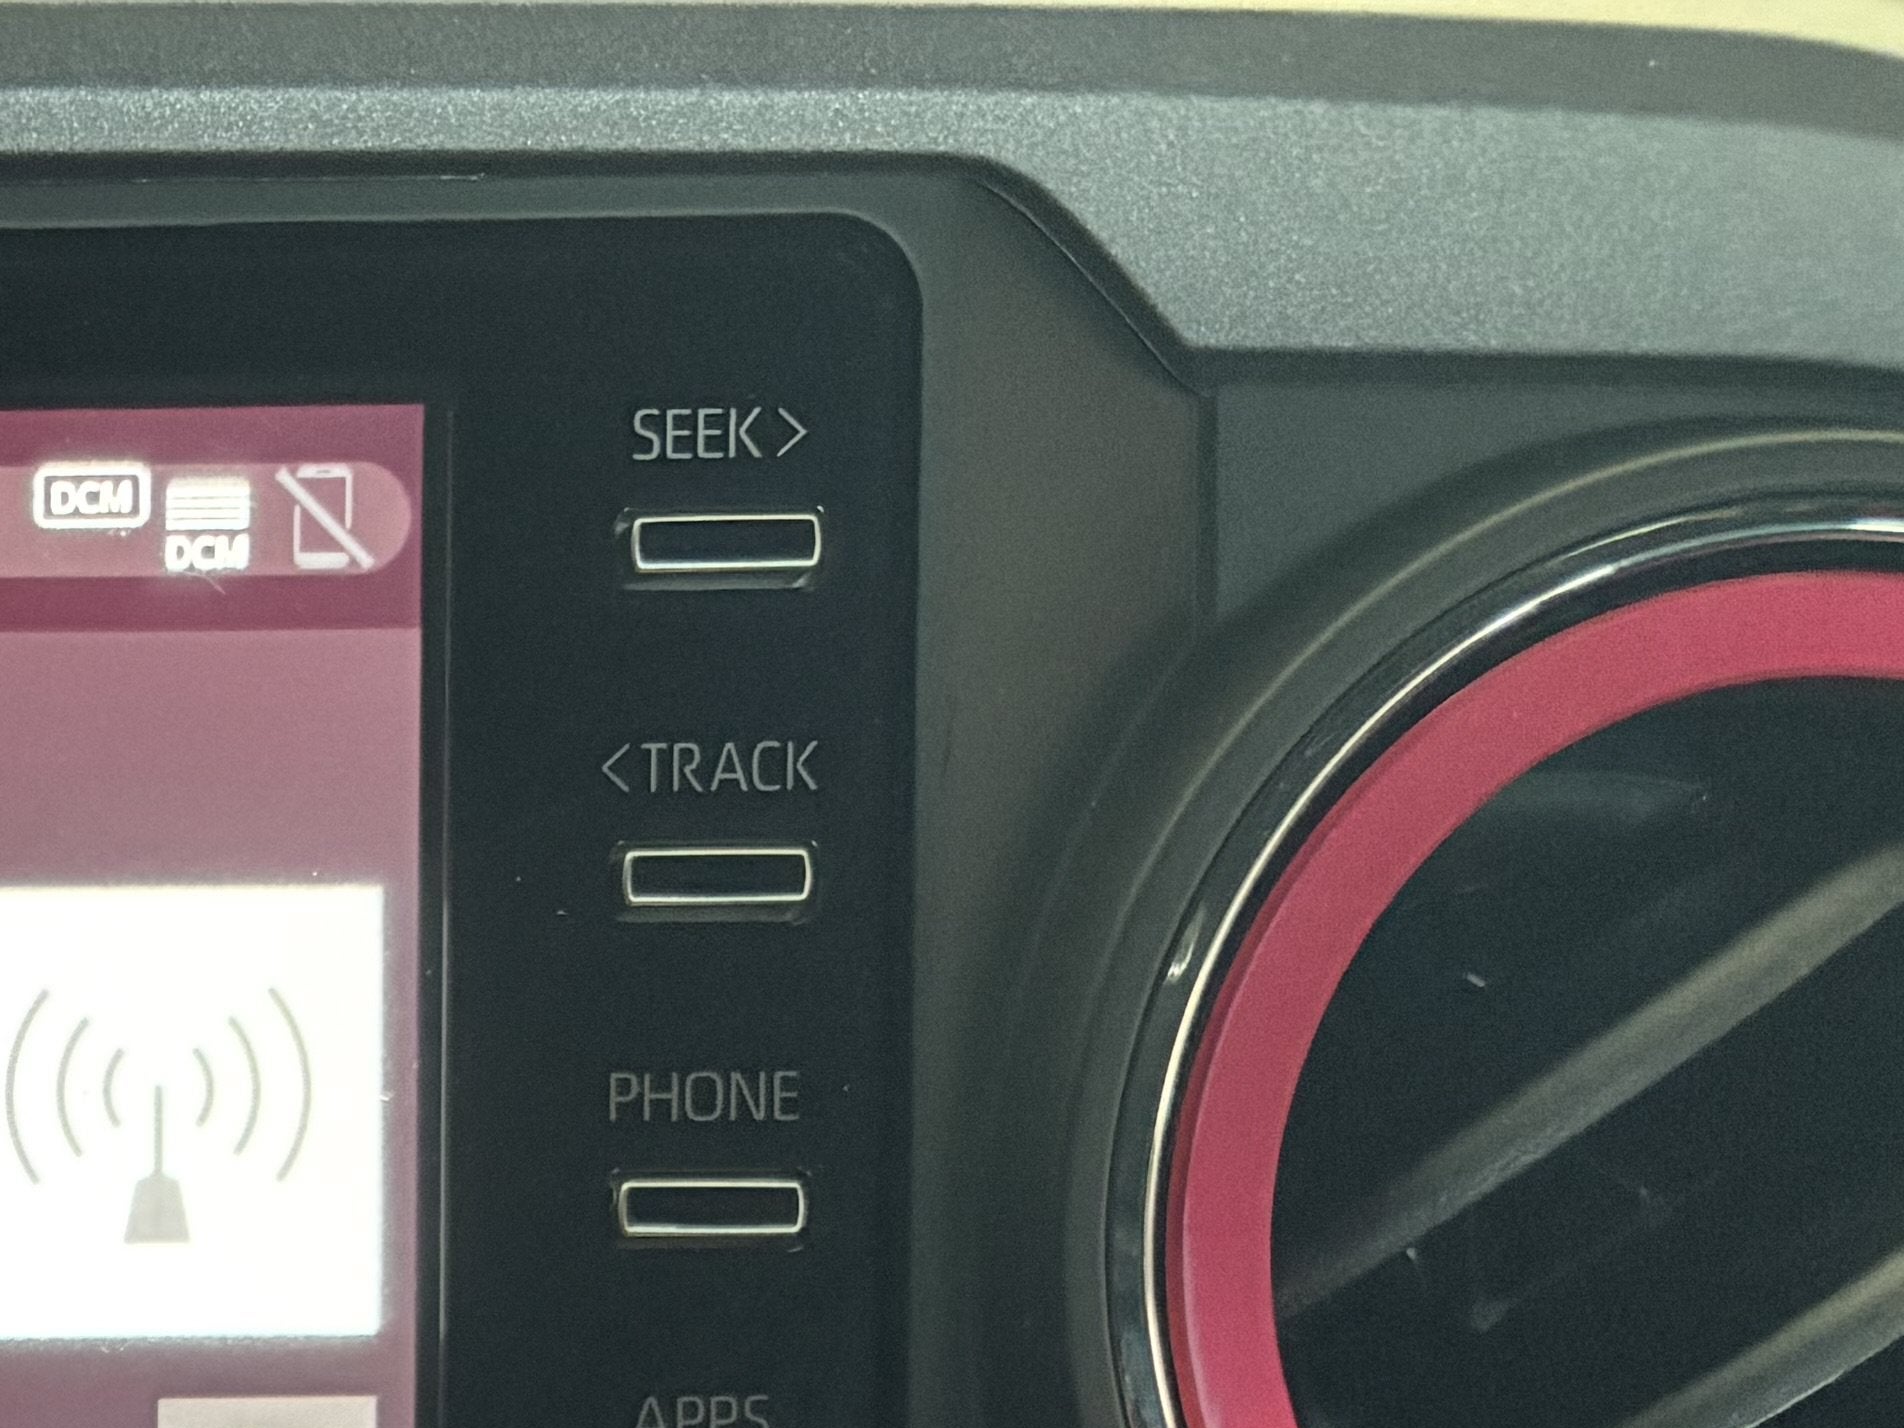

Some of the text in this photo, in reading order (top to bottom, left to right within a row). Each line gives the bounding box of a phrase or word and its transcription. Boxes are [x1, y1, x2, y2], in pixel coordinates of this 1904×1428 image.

[632, 407, 763, 460] SEEK
[50, 479, 133, 516] DCM
[165, 533, 250, 572] DCM
[641, 740, 819, 793] TRACK
[609, 1071, 800, 1122] PHONE
